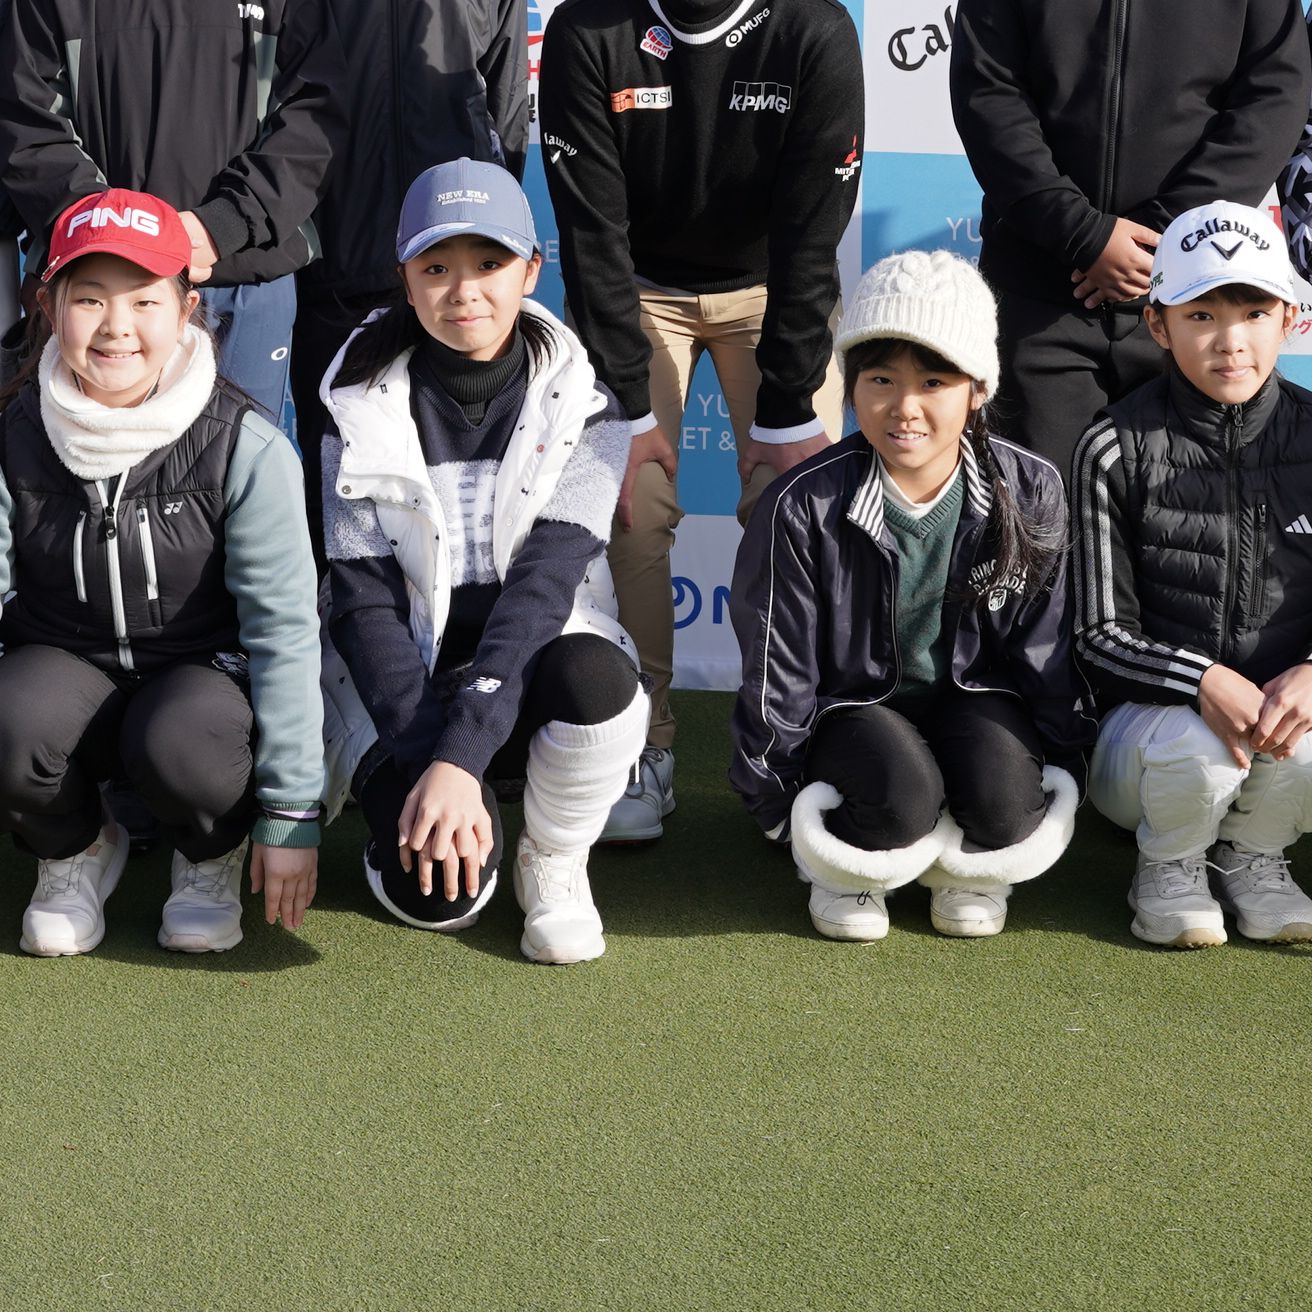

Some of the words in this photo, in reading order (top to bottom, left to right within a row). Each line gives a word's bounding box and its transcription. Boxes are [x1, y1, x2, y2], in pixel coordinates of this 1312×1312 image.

[740, 7, 771, 36] MUFG
[642, 41, 667, 59] EARTH
[636, 90, 671, 103] ICTSI
[728, 93, 793, 114] KPMG
[544, 132, 578, 156] laway
[437, 190, 463, 202] NEW
[466, 190, 490, 201] ERA
[66, 205, 160, 239] PING
[1180, 215, 1271, 253] Callaway
[697, 393, 730, 418] YU
[681, 425, 711, 452] ET
